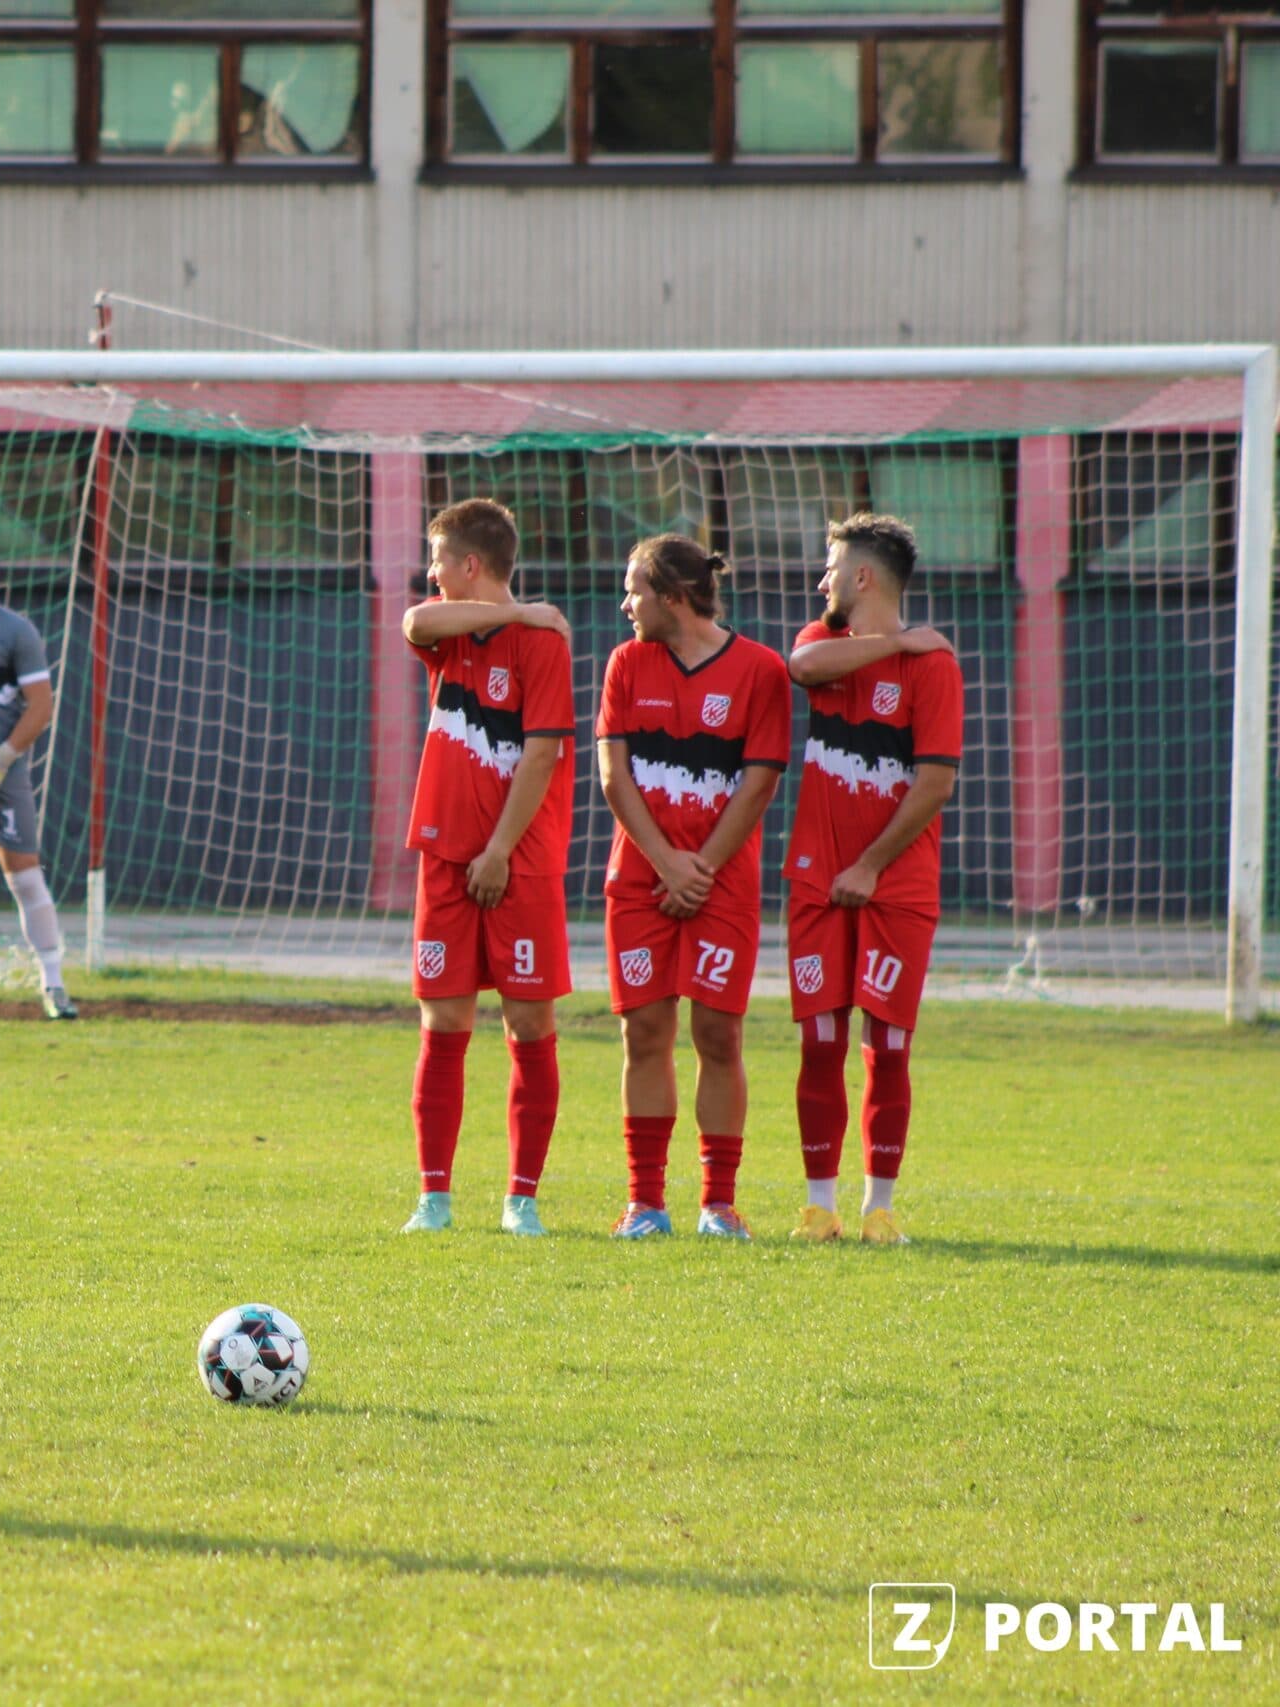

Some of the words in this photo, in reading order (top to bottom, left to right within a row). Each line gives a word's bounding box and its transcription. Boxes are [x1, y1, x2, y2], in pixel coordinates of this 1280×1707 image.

[2, 808, 17, 836] 1
[514, 939, 535, 976] 9
[696, 939, 735, 985] 72
[863, 949, 903, 993] 10
